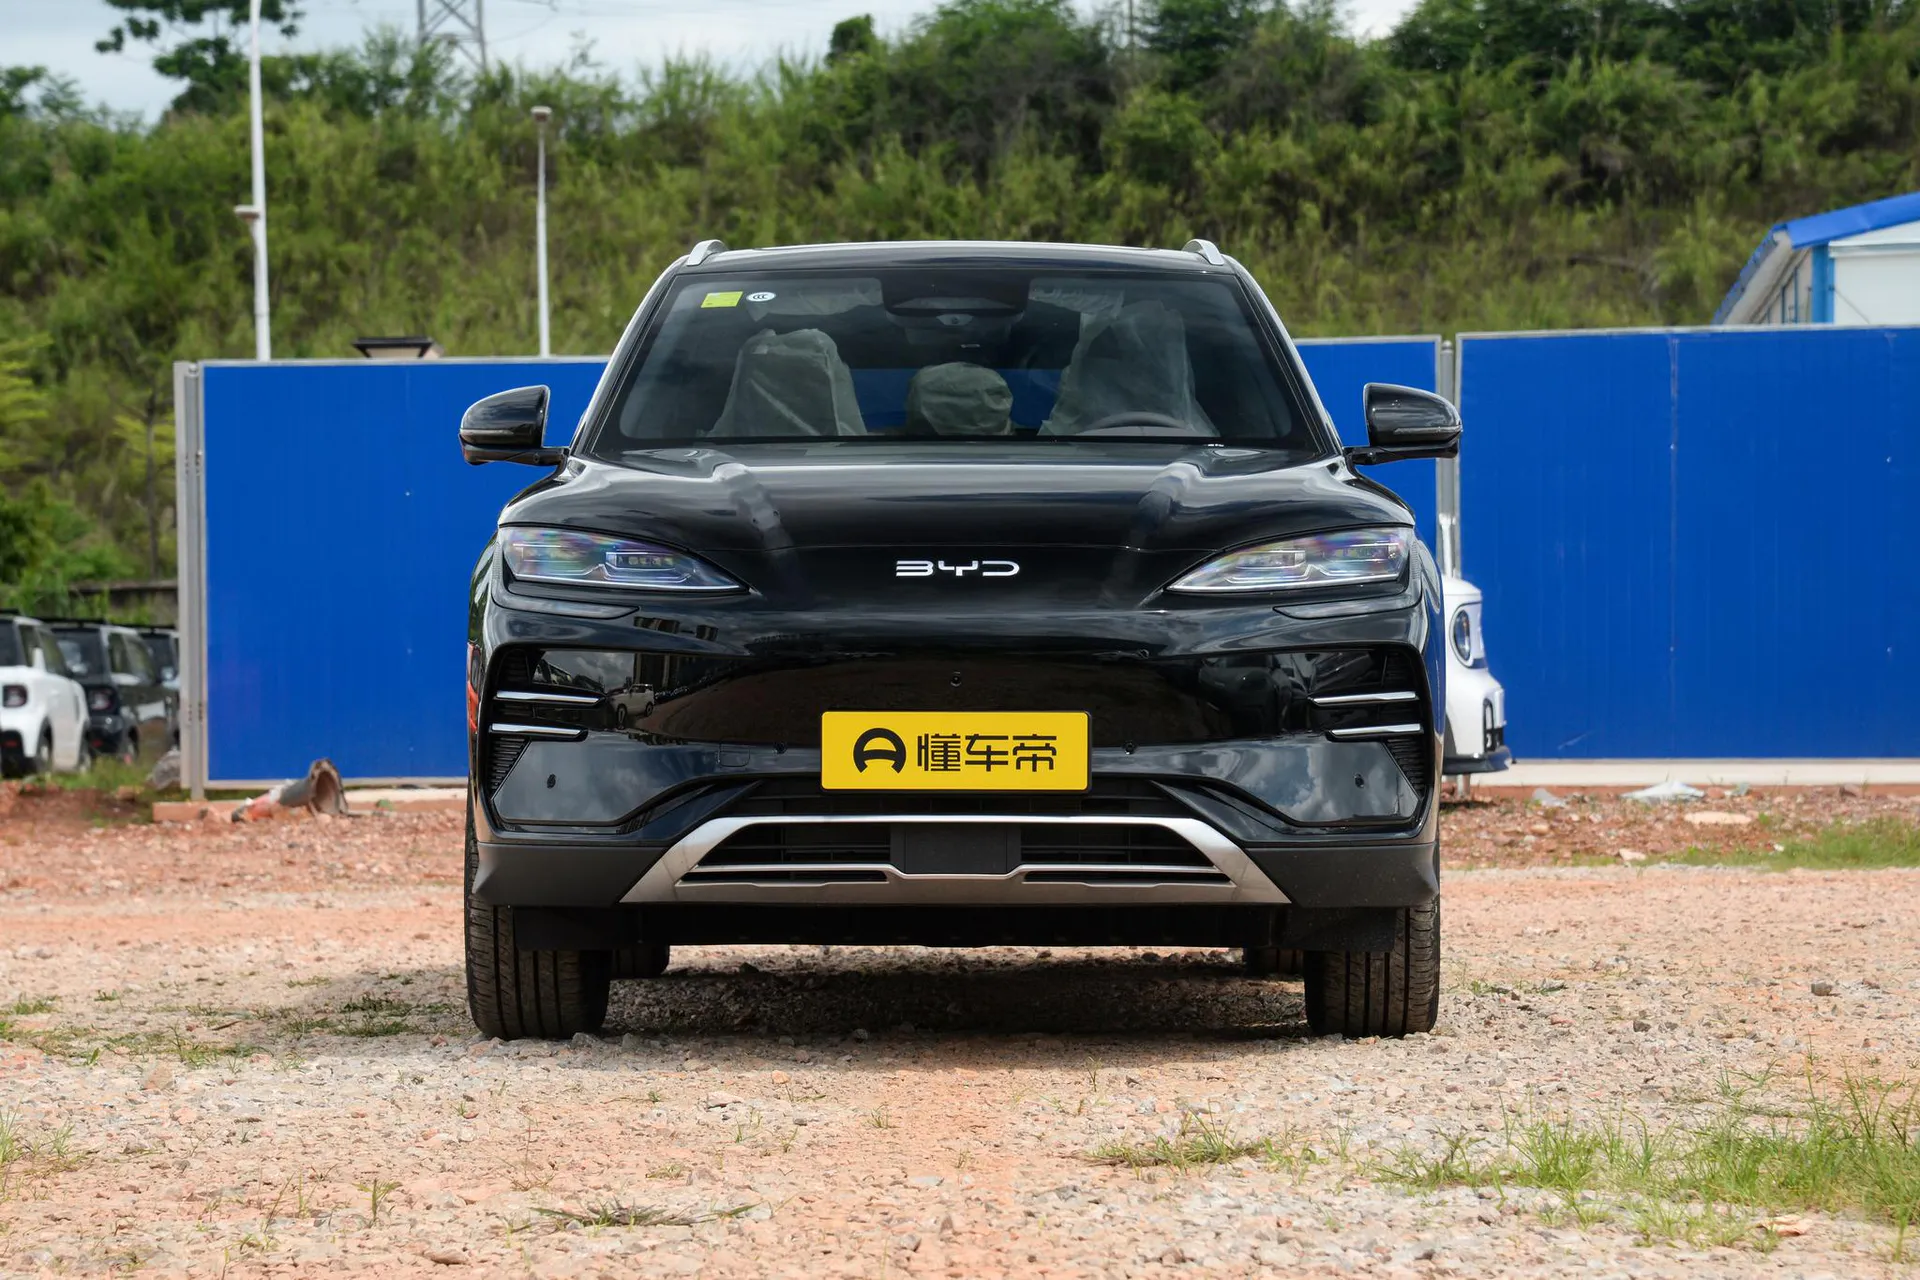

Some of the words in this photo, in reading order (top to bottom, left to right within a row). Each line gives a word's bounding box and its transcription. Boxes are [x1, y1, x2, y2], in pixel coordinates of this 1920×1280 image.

[896, 560, 1020, 577] BYD
[917, 733, 1057, 773] 懂车帝
